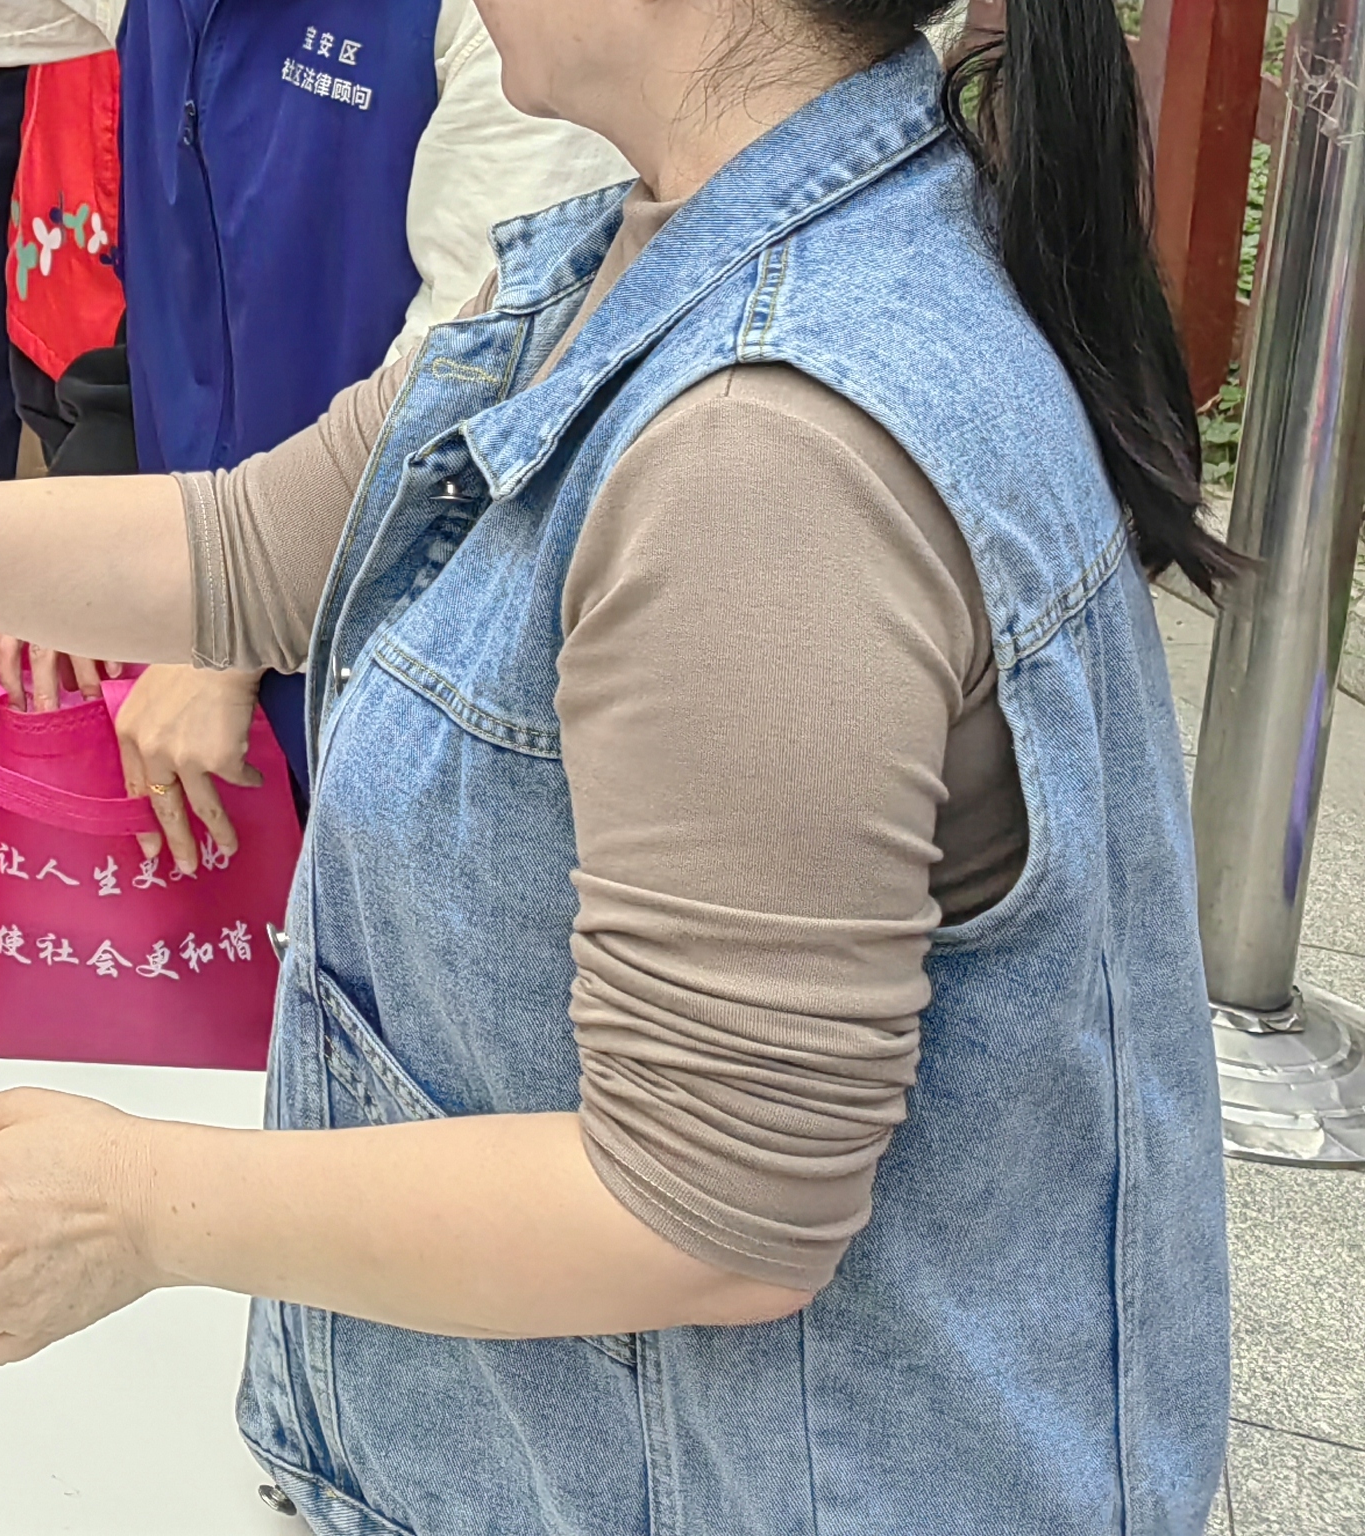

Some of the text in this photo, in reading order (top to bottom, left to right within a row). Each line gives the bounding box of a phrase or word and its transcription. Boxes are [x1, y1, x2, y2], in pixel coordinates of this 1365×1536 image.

[302, 25, 363, 66] 宝安区
[281, 57, 373, 111] 社区法律顾问
